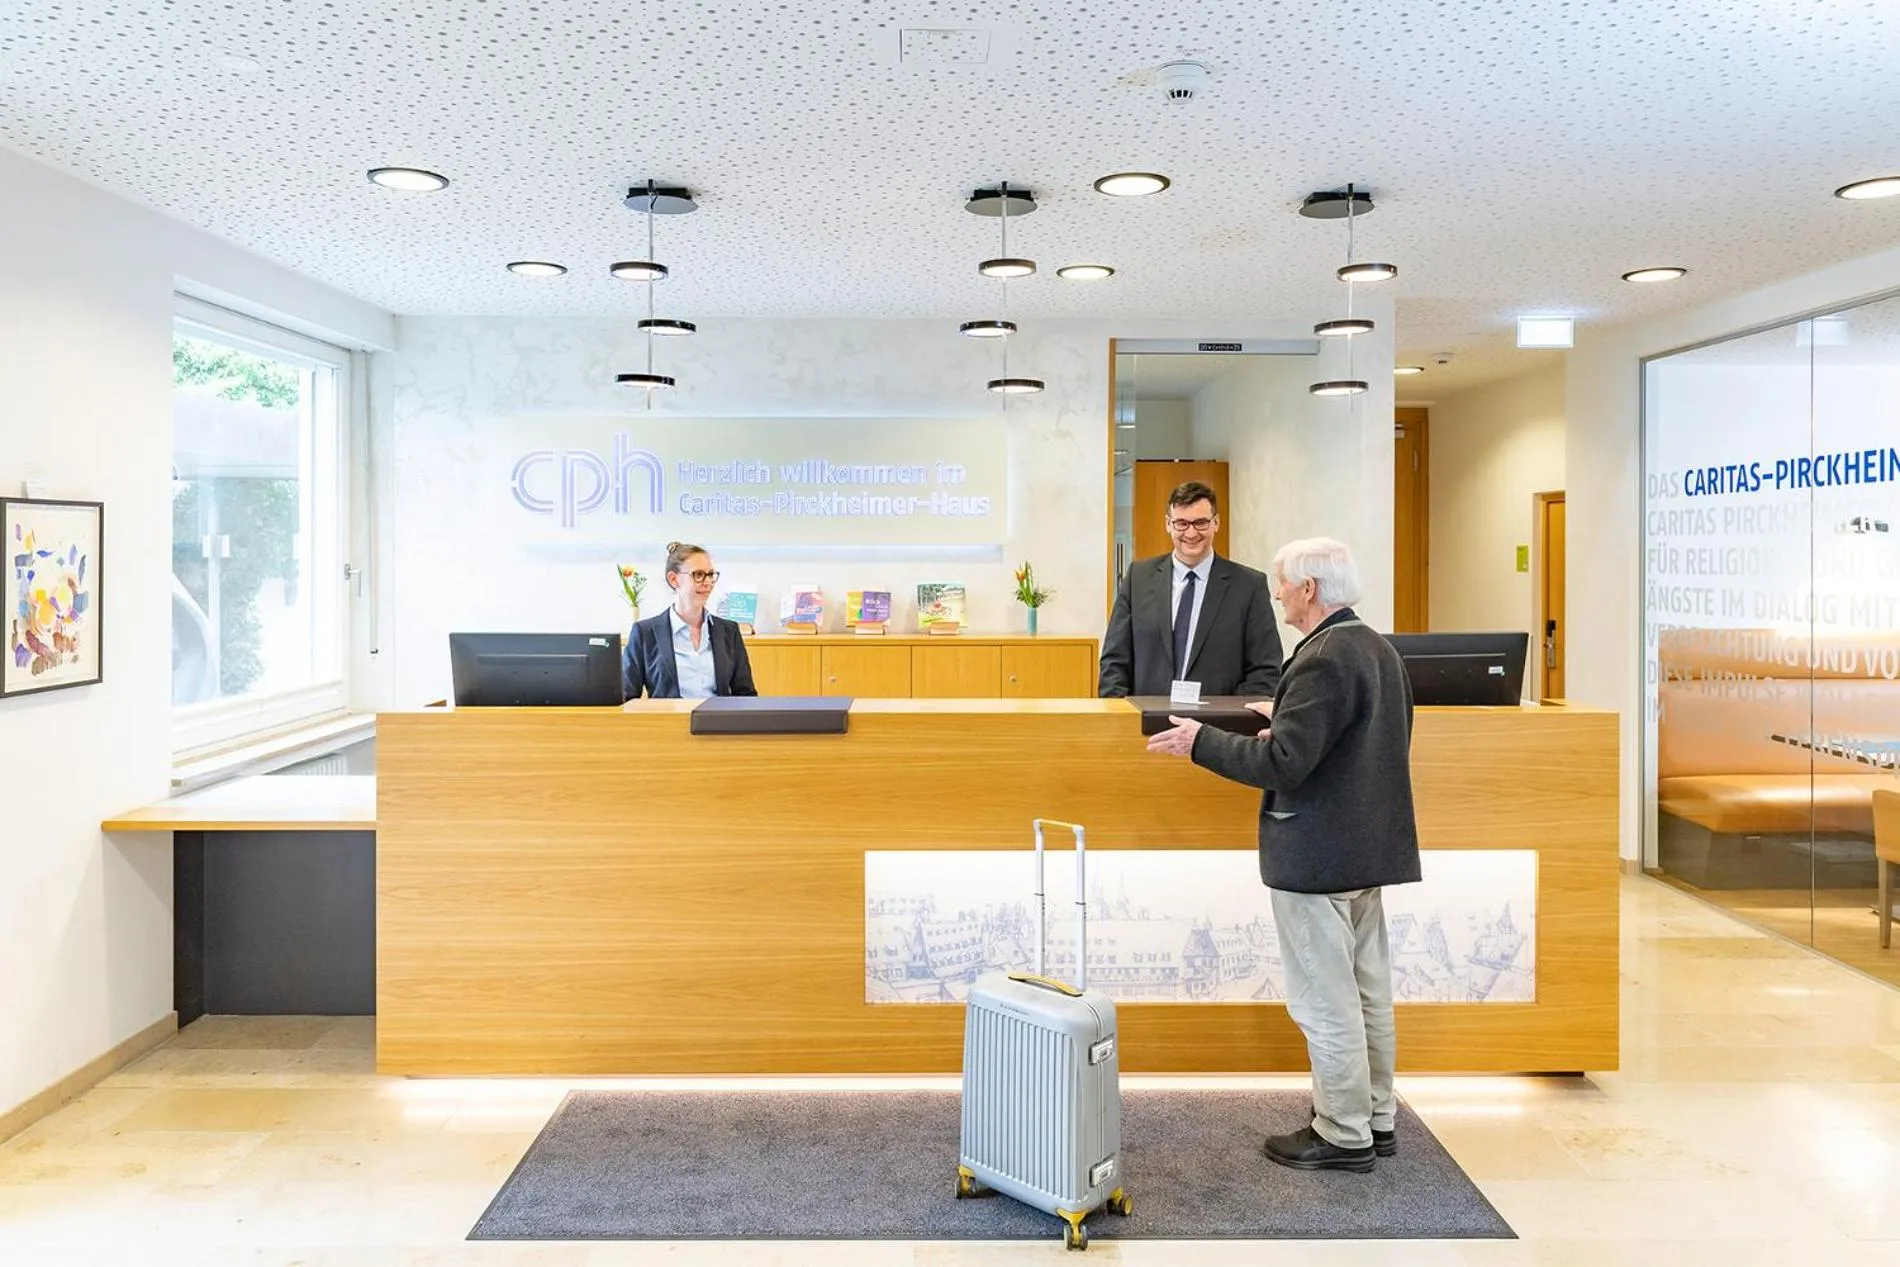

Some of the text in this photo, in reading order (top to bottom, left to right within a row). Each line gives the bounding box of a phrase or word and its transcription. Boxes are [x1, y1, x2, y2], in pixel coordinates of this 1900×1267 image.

[511, 431, 665, 528] cph
[678, 461, 967, 485] Herzlich willkommen im
[1648, 472, 1679, 499] DAS
[678, 491, 991, 517] Caritas-Pirckheimer-Haus
[1647, 507, 1717, 536] CARITAS
[1647, 542, 1680, 575] FÜR
[1646, 579, 1900, 630] ÄNGSTE IM DIALOG MIT
[1806, 644, 1857, 674] UND
